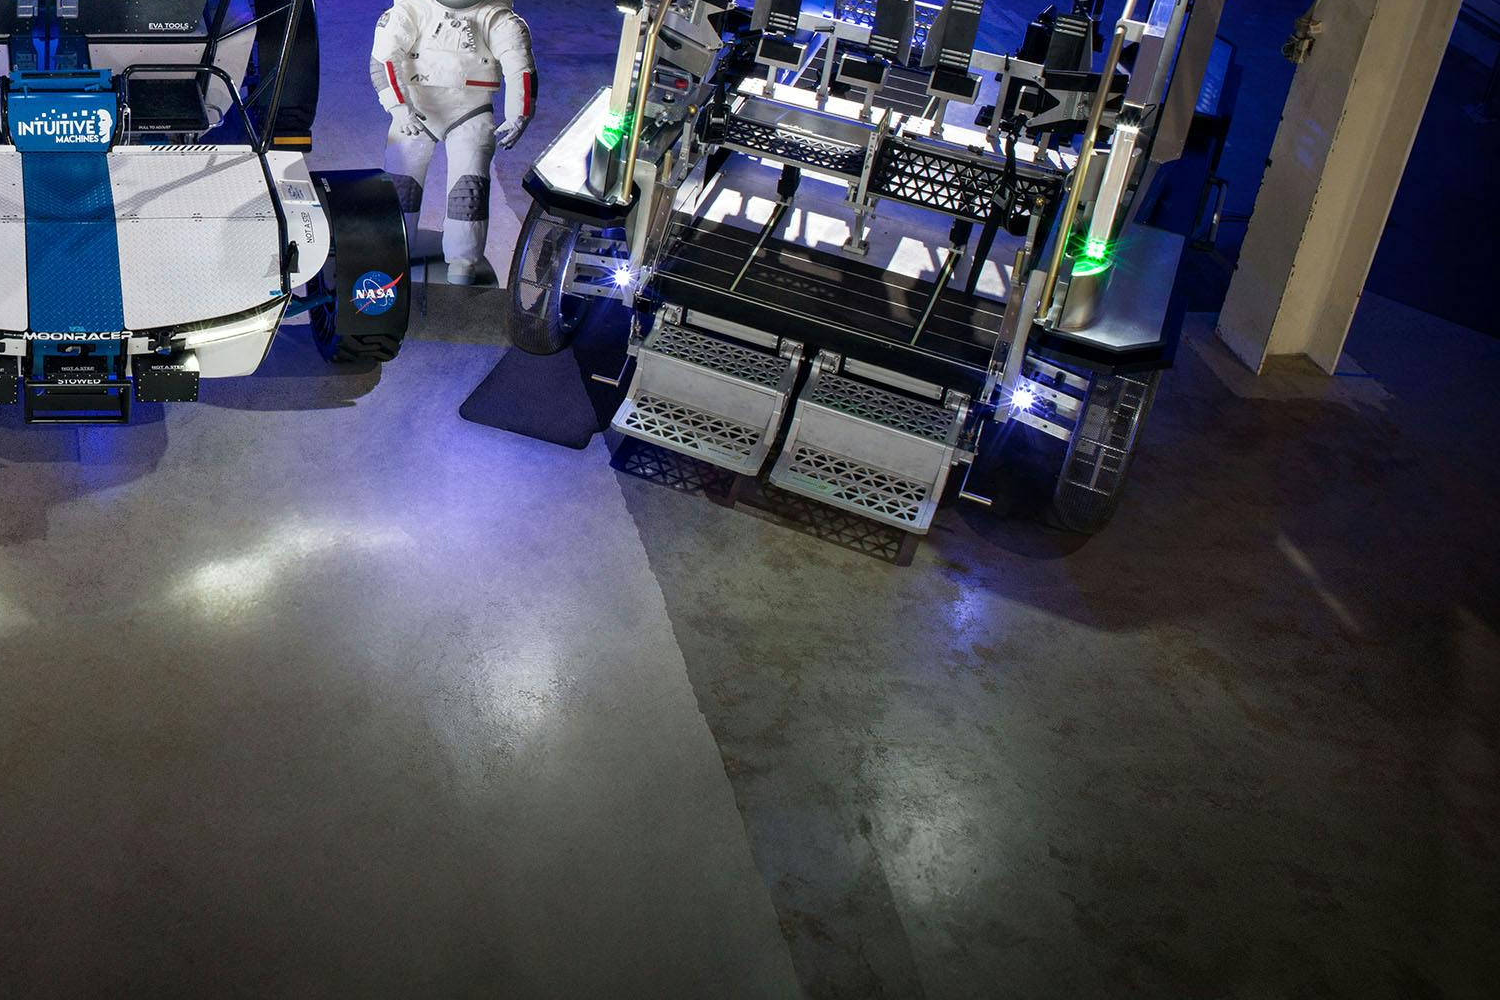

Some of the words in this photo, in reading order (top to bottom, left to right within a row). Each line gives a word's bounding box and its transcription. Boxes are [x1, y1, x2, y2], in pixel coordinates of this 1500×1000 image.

[164, 22, 189, 30] TOOLS
[17, 118, 96, 136] INTUITIVE
[55, 134, 100, 143] MACHINES
[355, 287, 395, 299] NASA
[23, 331, 134, 340] MOONRACER
